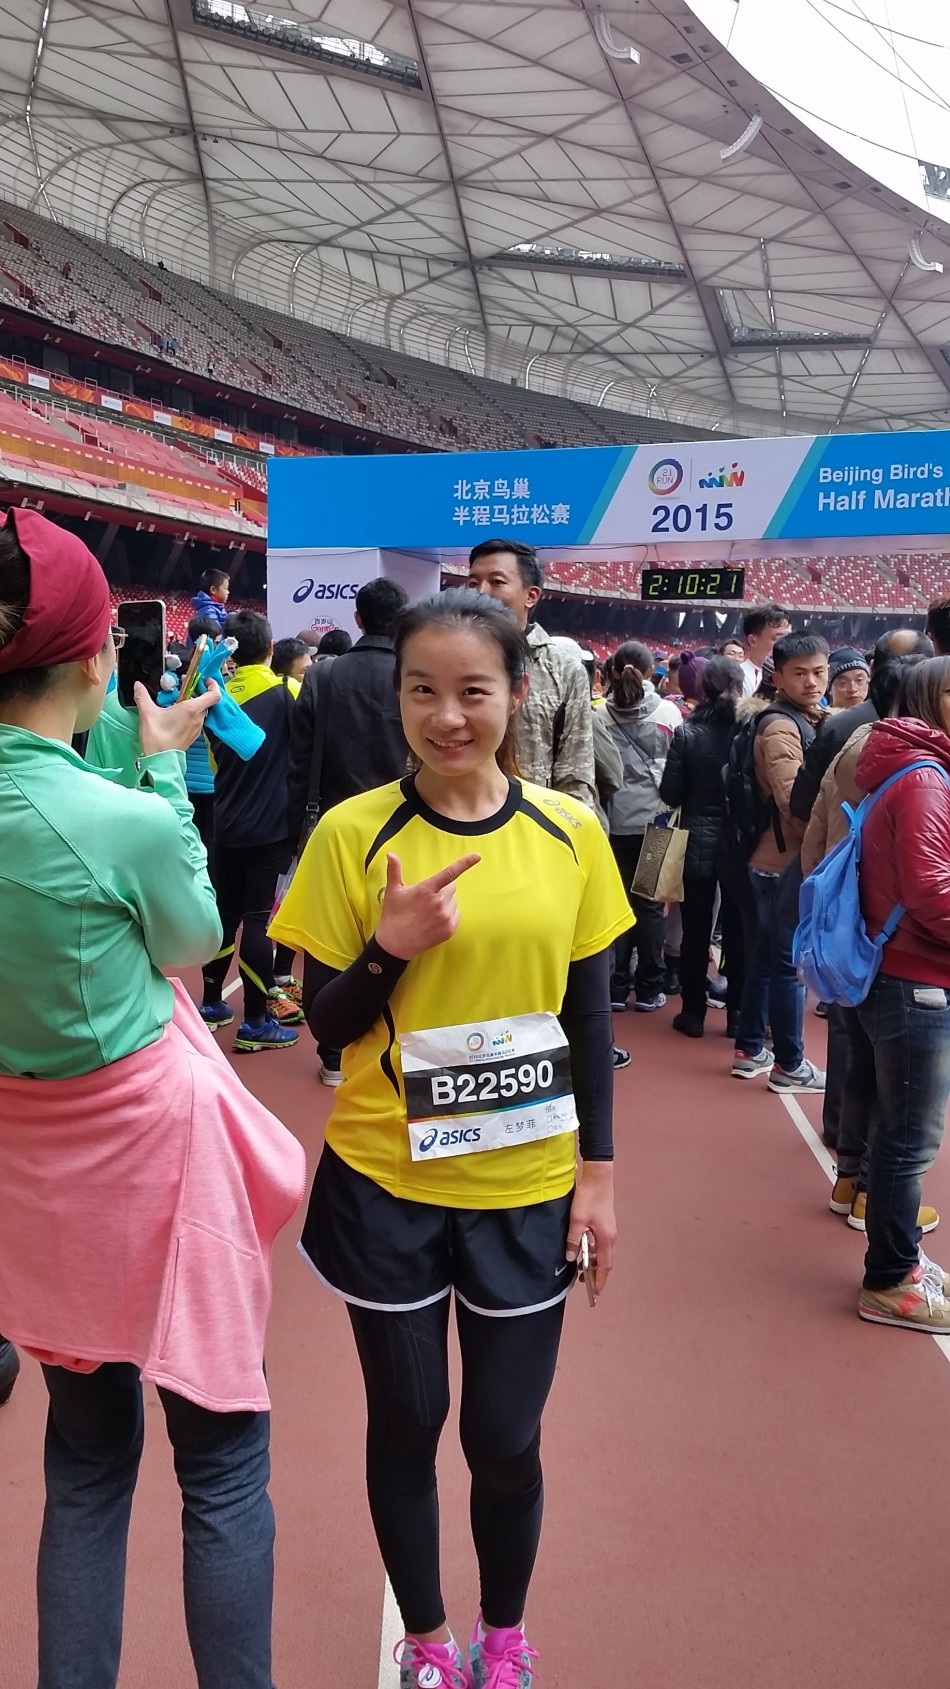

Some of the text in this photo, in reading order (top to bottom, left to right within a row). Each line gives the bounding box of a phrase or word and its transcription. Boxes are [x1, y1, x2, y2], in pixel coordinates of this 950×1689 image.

[656, 476, 674, 485] RUN
[819, 463, 944, 486] Beijing Bird's
[453, 478, 531, 500] 北京鸟巢
[818, 490, 867, 511] Half
[452, 503, 570, 526] 半程马拉松赛
[651, 503, 734, 532] 2015
[648, 573, 737, 595] 2:10:21
[431, 1059, 554, 1106] B22590
[439, 1127, 481, 1146] asics
[504, 1118, 536, 1134] 左梦菲
